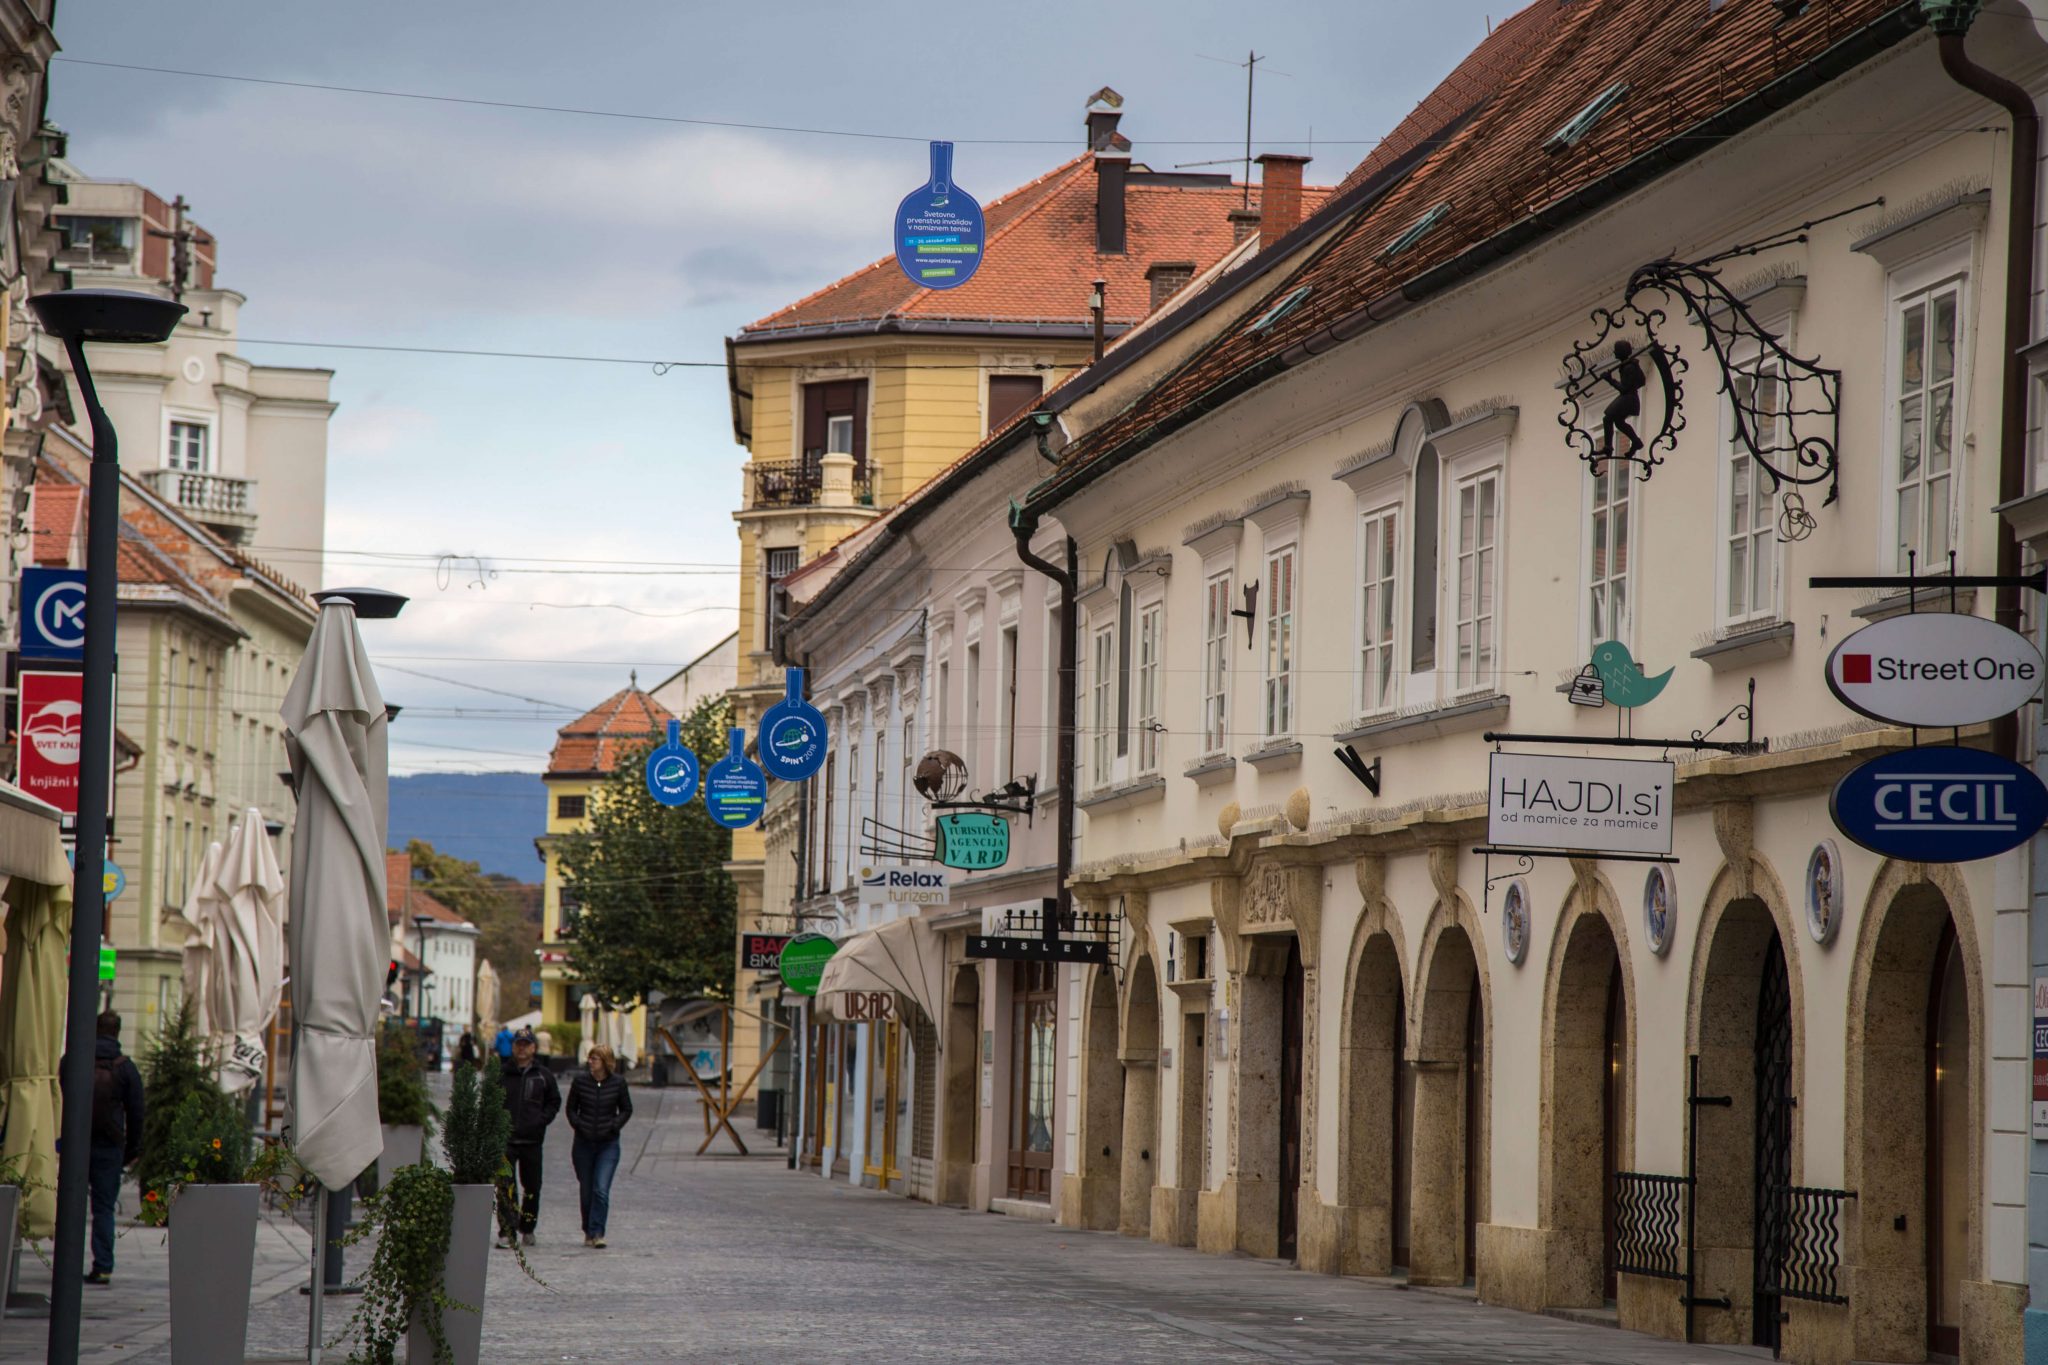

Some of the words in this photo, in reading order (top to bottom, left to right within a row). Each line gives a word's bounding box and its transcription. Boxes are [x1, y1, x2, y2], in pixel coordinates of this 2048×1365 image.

[942, 218, 973, 226] invalidov
[1876, 657, 1969, 681] Street
[1973, 657, 2036, 681] One
[36, 741, 57, 750] SVET
[780, 755, 804, 765] SPINT
[803, 744, 817, 760] 2018
[30, 776, 70, 789] knjižni
[1501, 777, 1662, 817] HAJDI.si
[1874, 783, 2017, 821] CECIL
[1501, 812, 1518, 823] od
[1523, 813, 1578, 826] mamice
[1583, 818, 1599, 827] za
[1604, 819, 1659, 830] mamice
[949, 825, 1005, 836] TURISTIČNA
[951, 838, 1004, 848] AGENCIJA
[951, 849, 1003, 864] VARD
[890, 871, 943, 887] Relax
[888, 888, 944, 903] turizem
[980, 940, 1093, 953] SISLEY
[845, 992, 892, 1020] URAR
